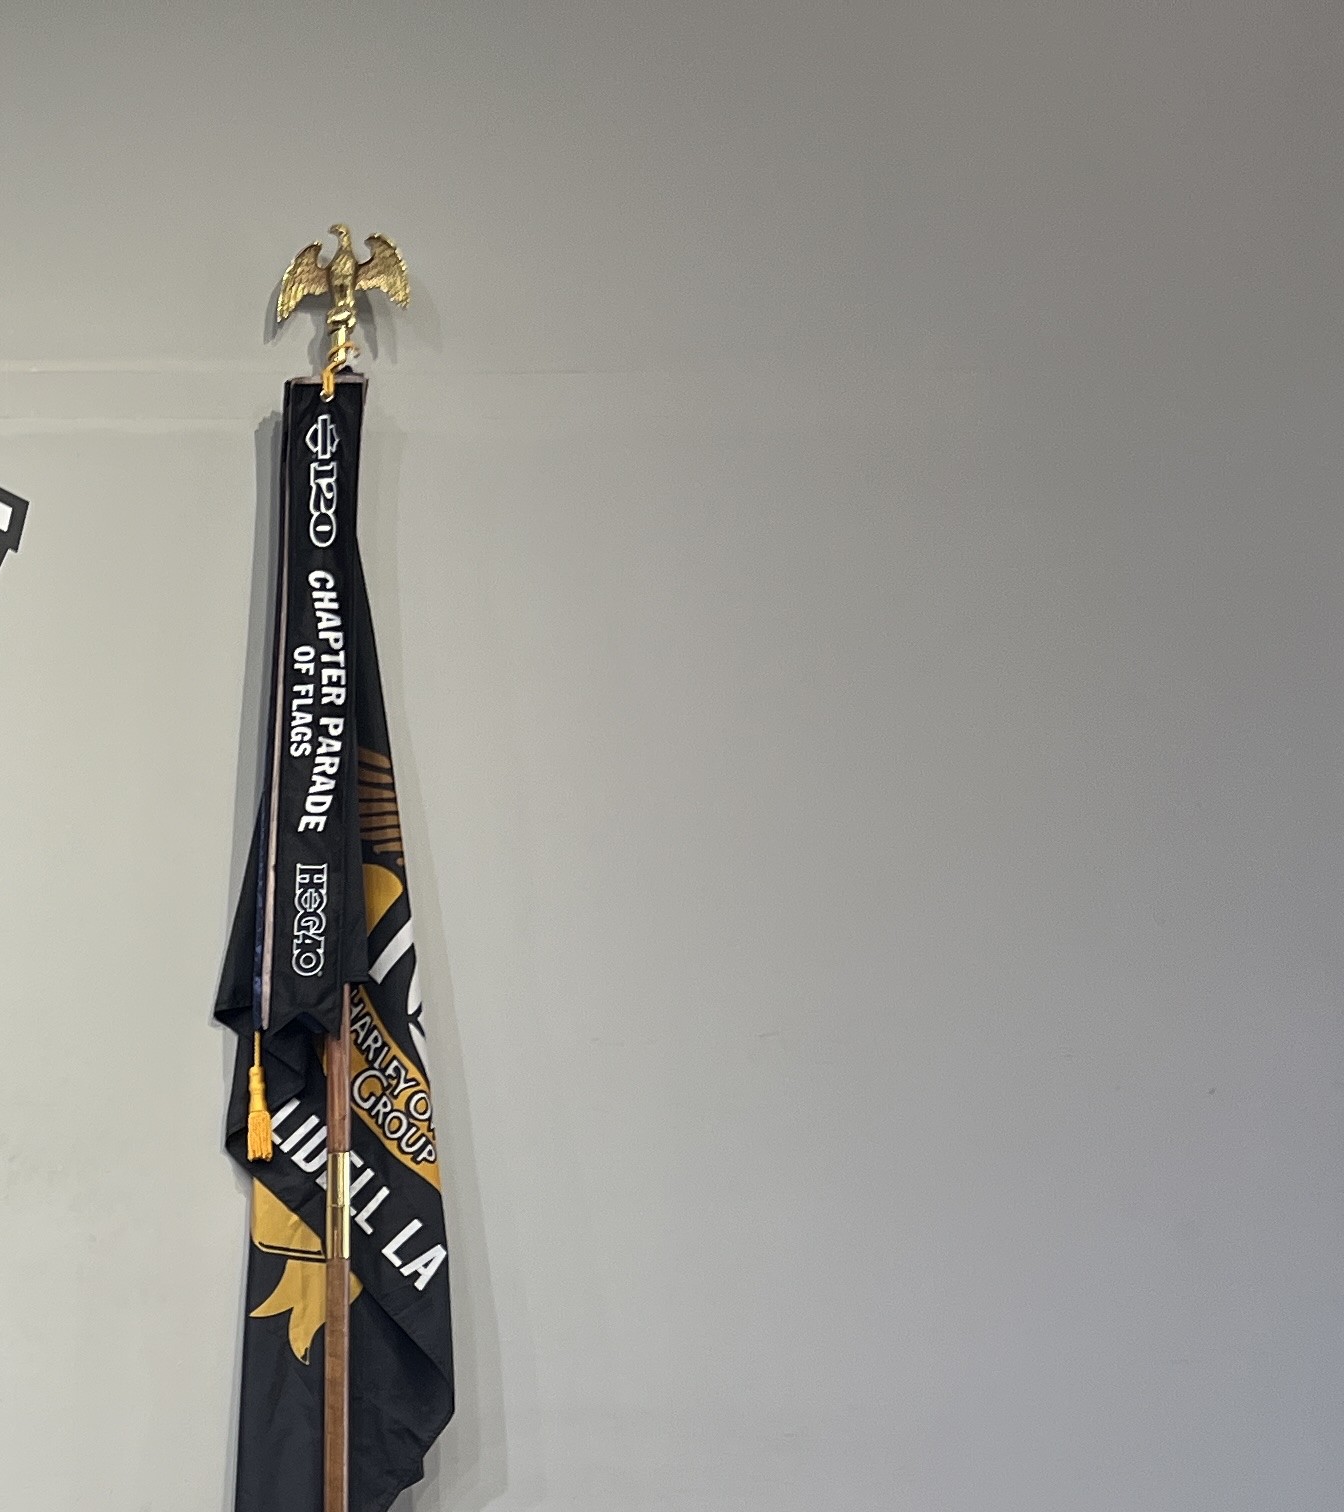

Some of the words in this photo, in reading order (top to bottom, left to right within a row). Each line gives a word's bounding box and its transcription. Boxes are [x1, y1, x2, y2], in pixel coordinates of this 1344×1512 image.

[293, 645, 315, 676] OF
[308, 570, 346, 707] CHAPTER
[289, 683, 314, 758] FLAGS
[297, 715, 345, 833] PARADE
[353, 1069, 437, 1164] GROUP
[381, 1219, 447, 1291] LA
